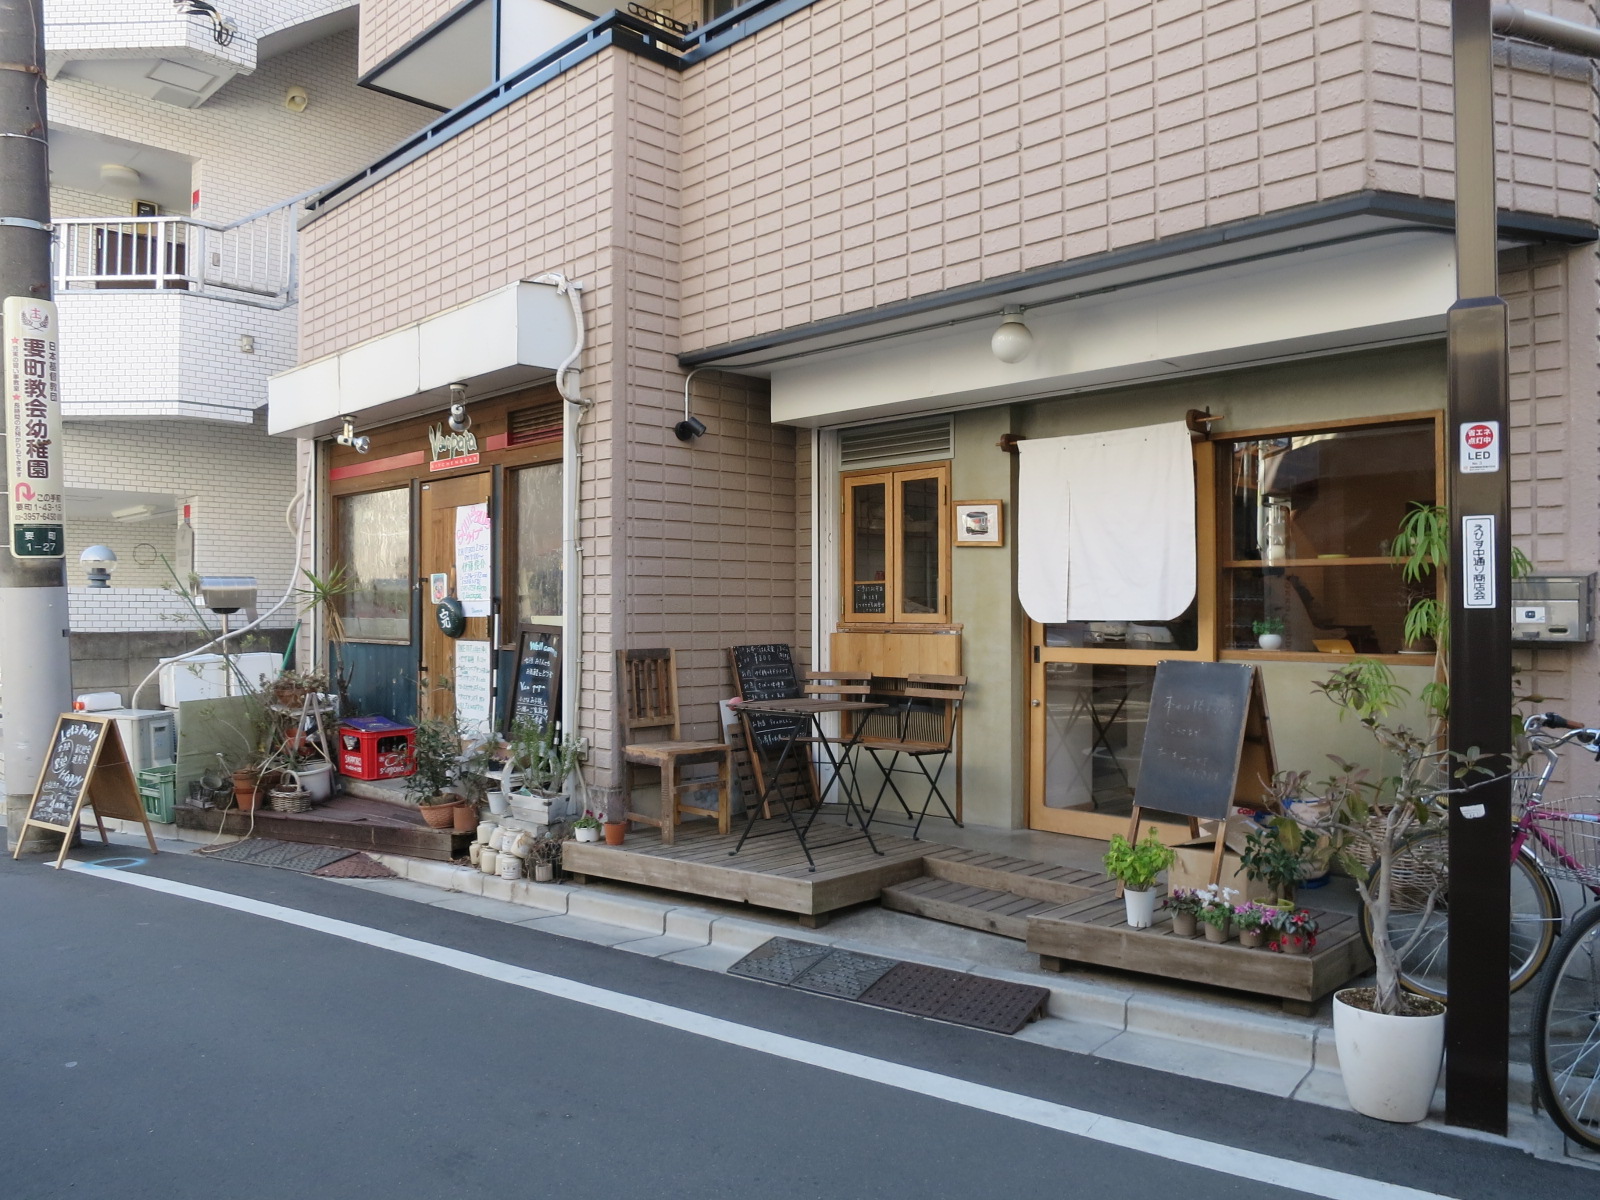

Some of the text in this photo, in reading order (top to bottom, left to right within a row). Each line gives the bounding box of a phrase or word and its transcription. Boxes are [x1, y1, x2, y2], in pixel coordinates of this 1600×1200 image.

[23, 338, 49, 479] 要町教会幼稚園
[1467, 428, 1491, 437] 省エネ
[1467, 436, 1491, 445] 点灯中
[1467, 450, 1491, 461] LED
[79, 723, 99, 742] Party
[58, 769, 84, 788] Happy
